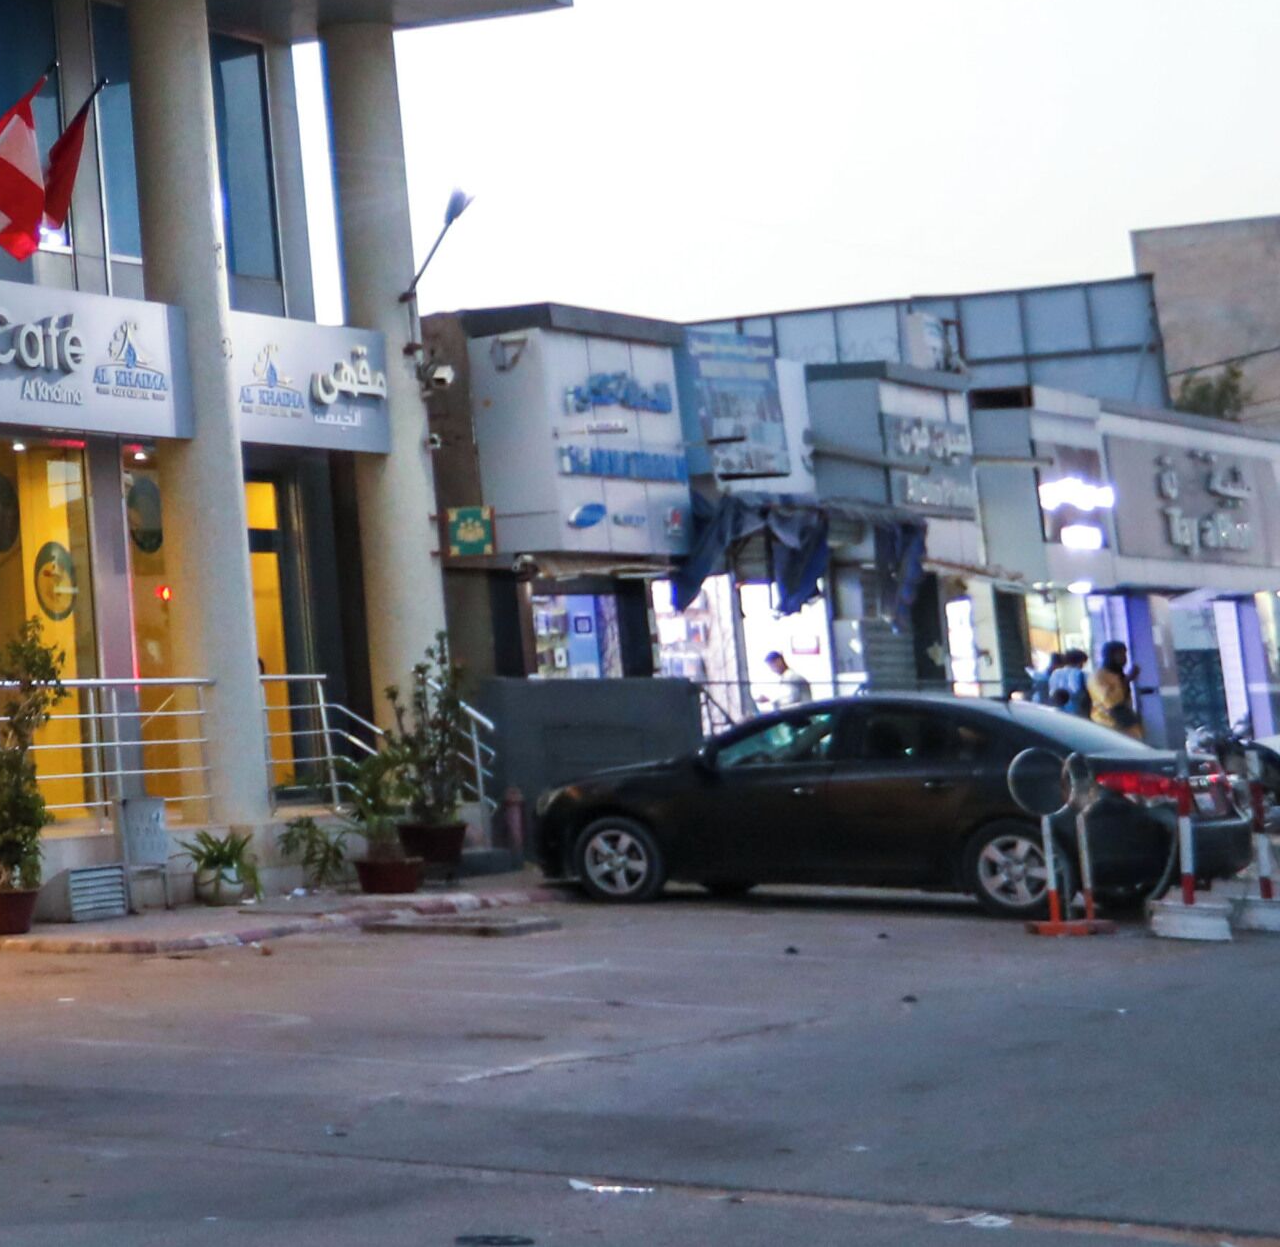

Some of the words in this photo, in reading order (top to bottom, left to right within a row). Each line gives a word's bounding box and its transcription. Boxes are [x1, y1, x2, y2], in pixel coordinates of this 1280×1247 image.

[93, 367, 110, 385] AL
[115, 370, 168, 391] KHAIMA
[238, 388, 254, 404] AL
[258, 389, 305, 409] KHAIMA
